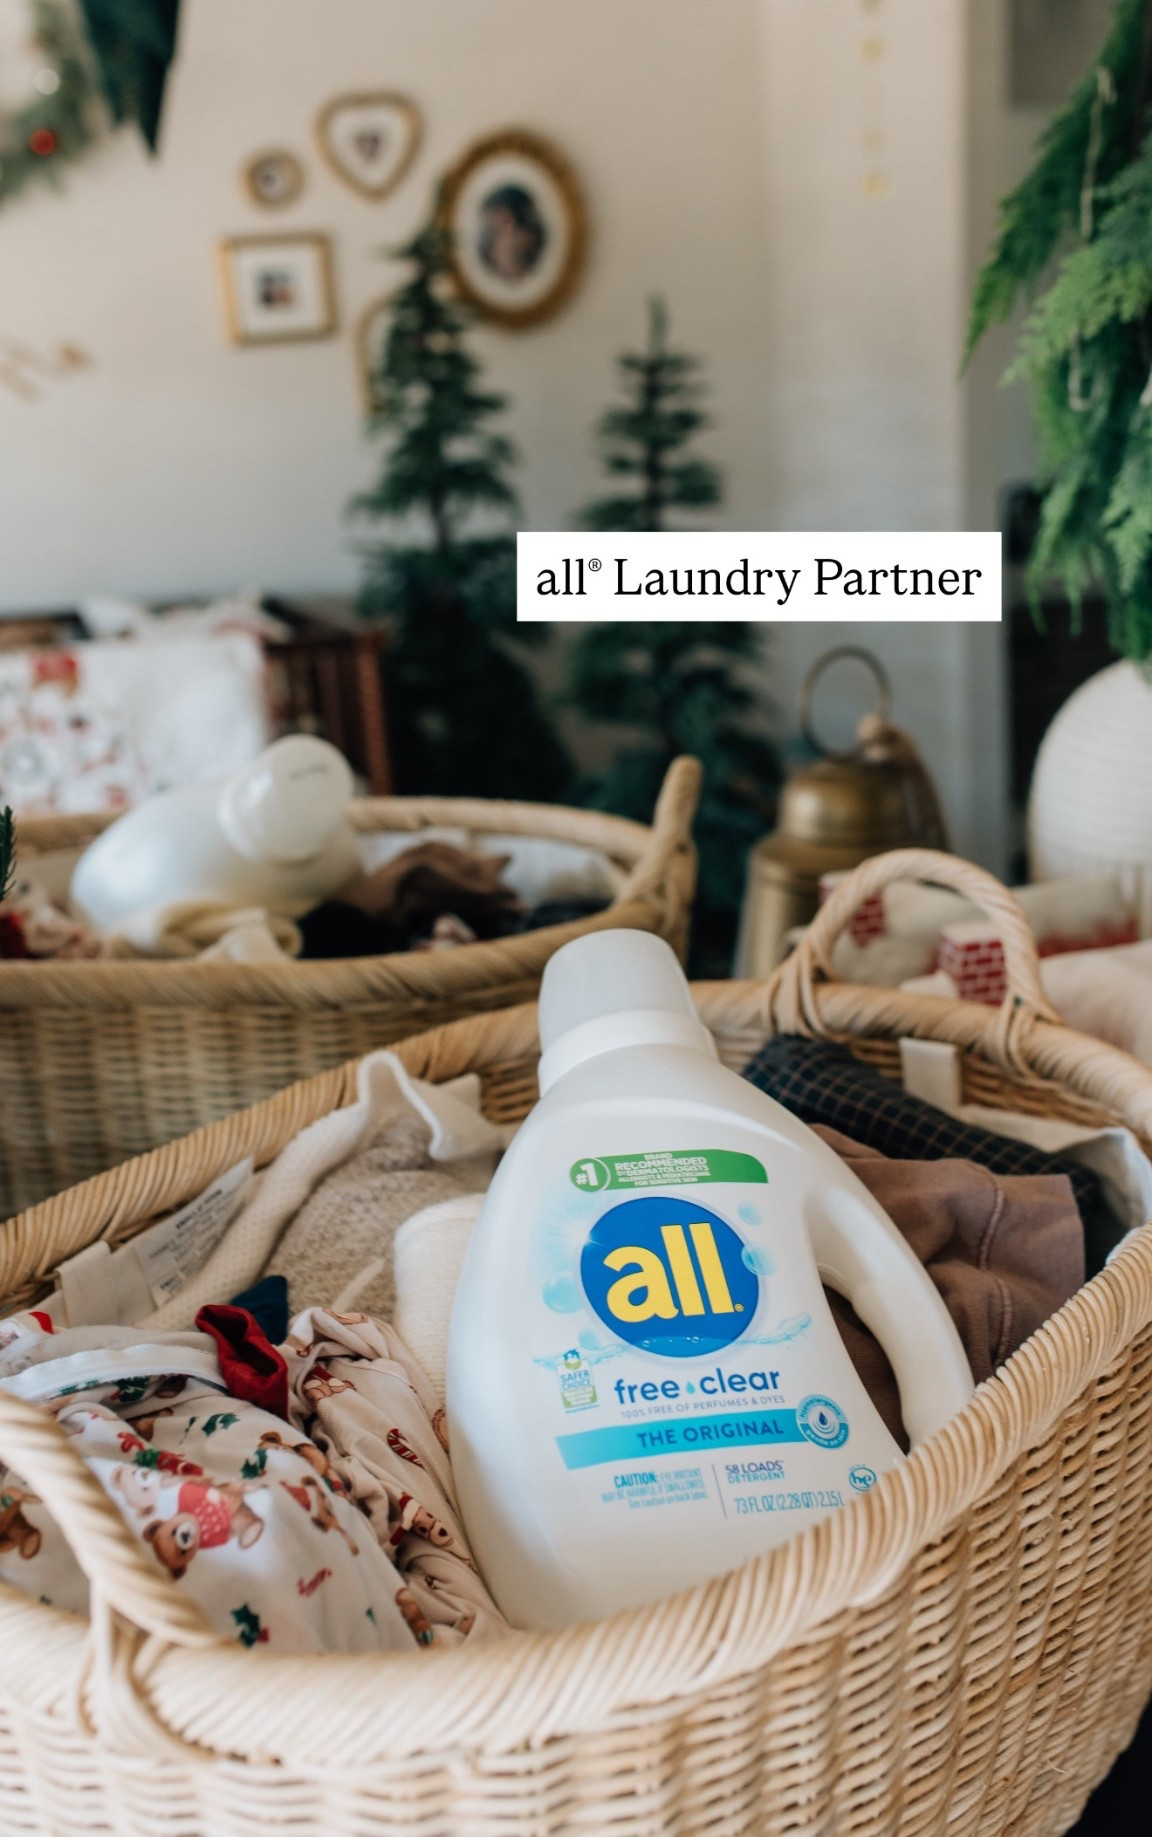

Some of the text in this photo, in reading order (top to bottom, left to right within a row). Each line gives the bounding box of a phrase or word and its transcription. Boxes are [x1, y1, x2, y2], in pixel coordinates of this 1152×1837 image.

[614, 1157, 707, 1171] RECOMMENDED
[644, 1153, 673, 1161] BRAND
[576, 1163, 599, 1186] #1
[626, 1165, 709, 1177] DERMATOLOGISTS
[560, 1370, 590, 1381] SAFER
[561, 1380, 592, 1391] CHOICE
[614, 1379, 680, 1404] free
[699, 1367, 780, 1395] clear
[621, 1395, 785, 1418] 100% FREE OF PERFUMES & DYES
[636, 1420, 784, 1448] THE ORIGINAL
[725, 1463, 740, 1475] 58
[613, 1471, 660, 1488] CAUTION:
[727, 1471, 785, 1484] DETERGENT
[734, 1497, 748, 1514] 73
[750, 1495, 761, 1512] FL
[762, 1494, 775, 1511] OZ
[776, 1493, 800, 1510] (2.28
[801, 1491, 819, 1508] QT)
[820, 1490, 839, 1507] 2.15
